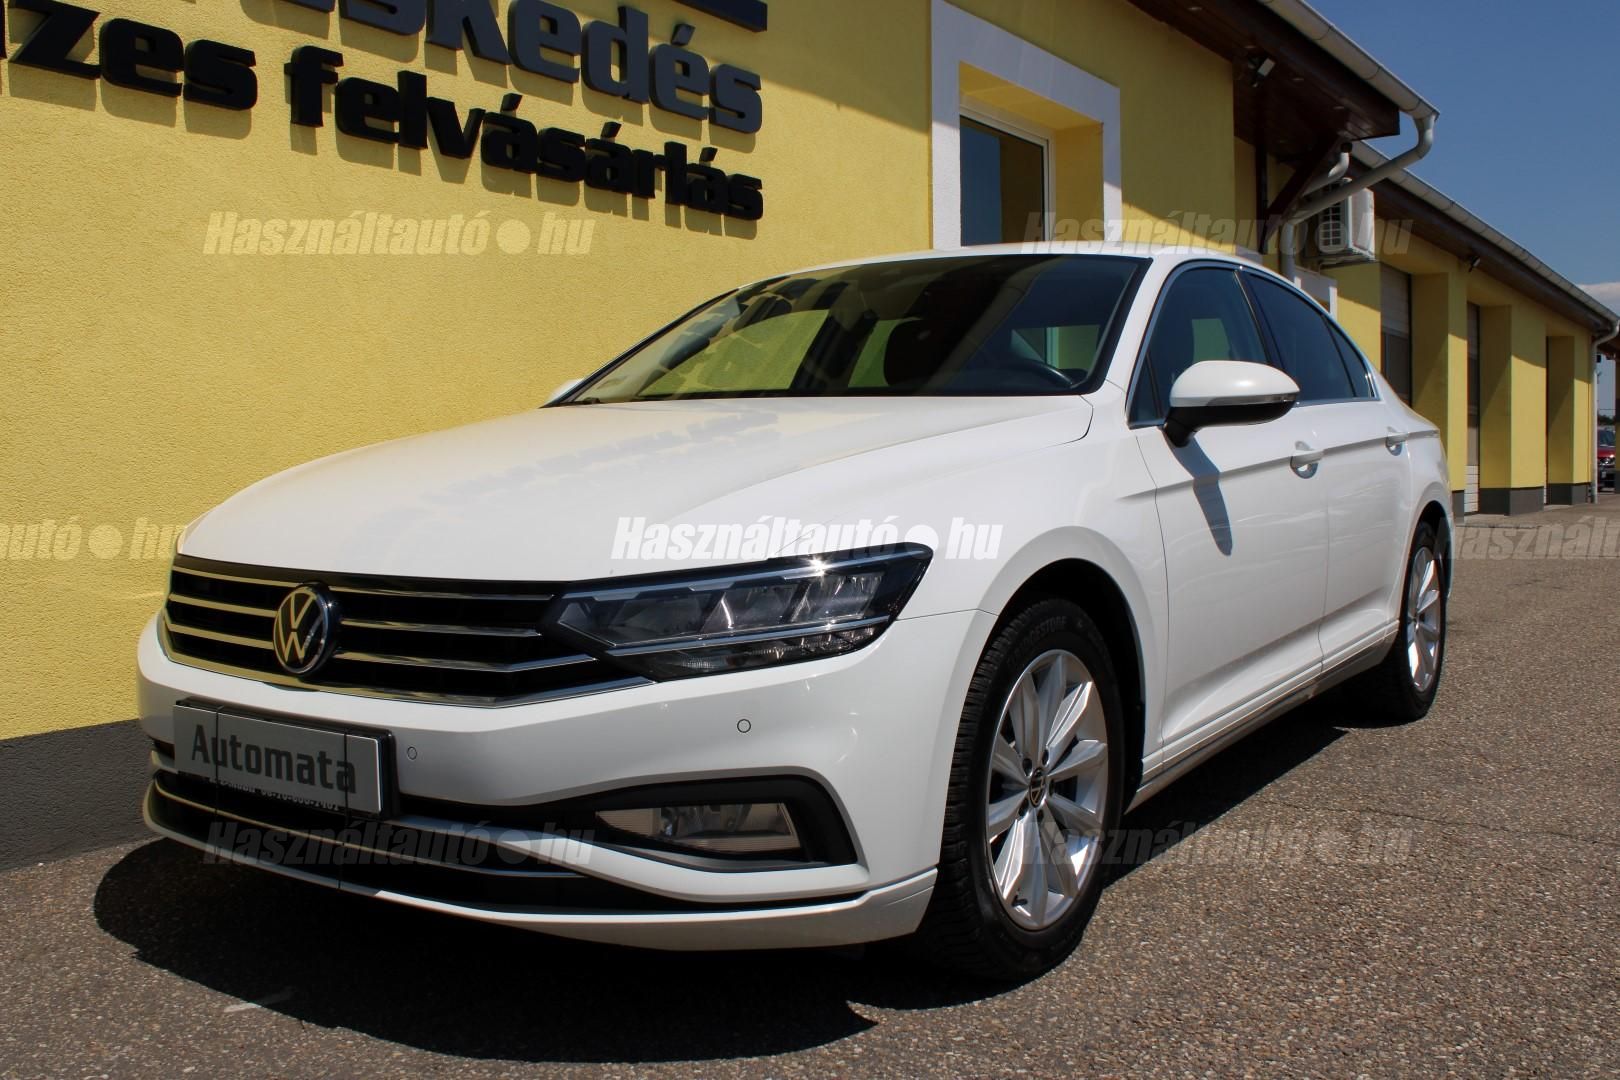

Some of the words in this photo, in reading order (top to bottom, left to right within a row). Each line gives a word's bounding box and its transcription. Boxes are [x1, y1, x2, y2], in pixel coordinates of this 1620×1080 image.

[0, 0, 258, 111] zes
[284, 44, 764, 220] felvásárlás
[191, 724, 356, 793] Automata
